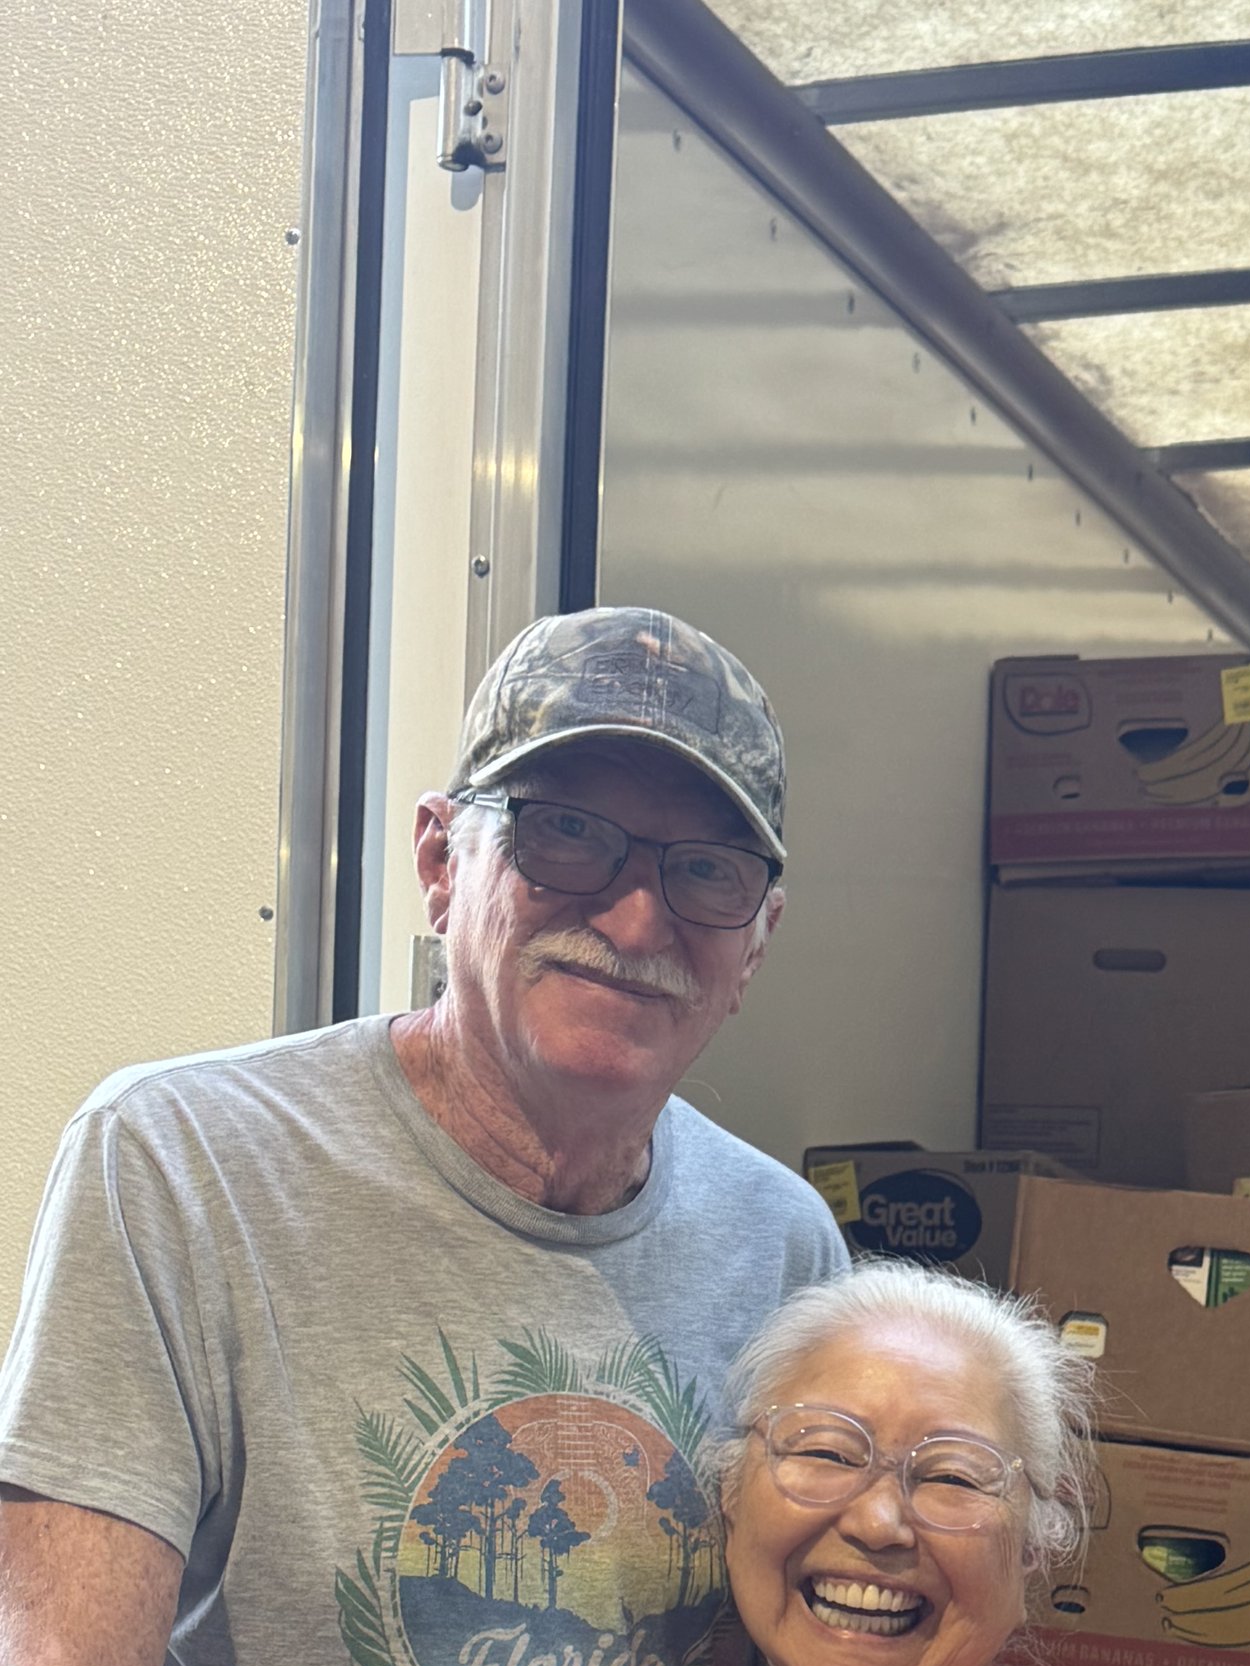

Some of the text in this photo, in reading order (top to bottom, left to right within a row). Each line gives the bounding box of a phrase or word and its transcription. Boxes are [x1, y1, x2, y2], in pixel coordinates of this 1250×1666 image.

[1019, 685, 1079, 713] Dole
[862, 1193, 956, 1228] Great
[885, 1224, 957, 1248] Value
